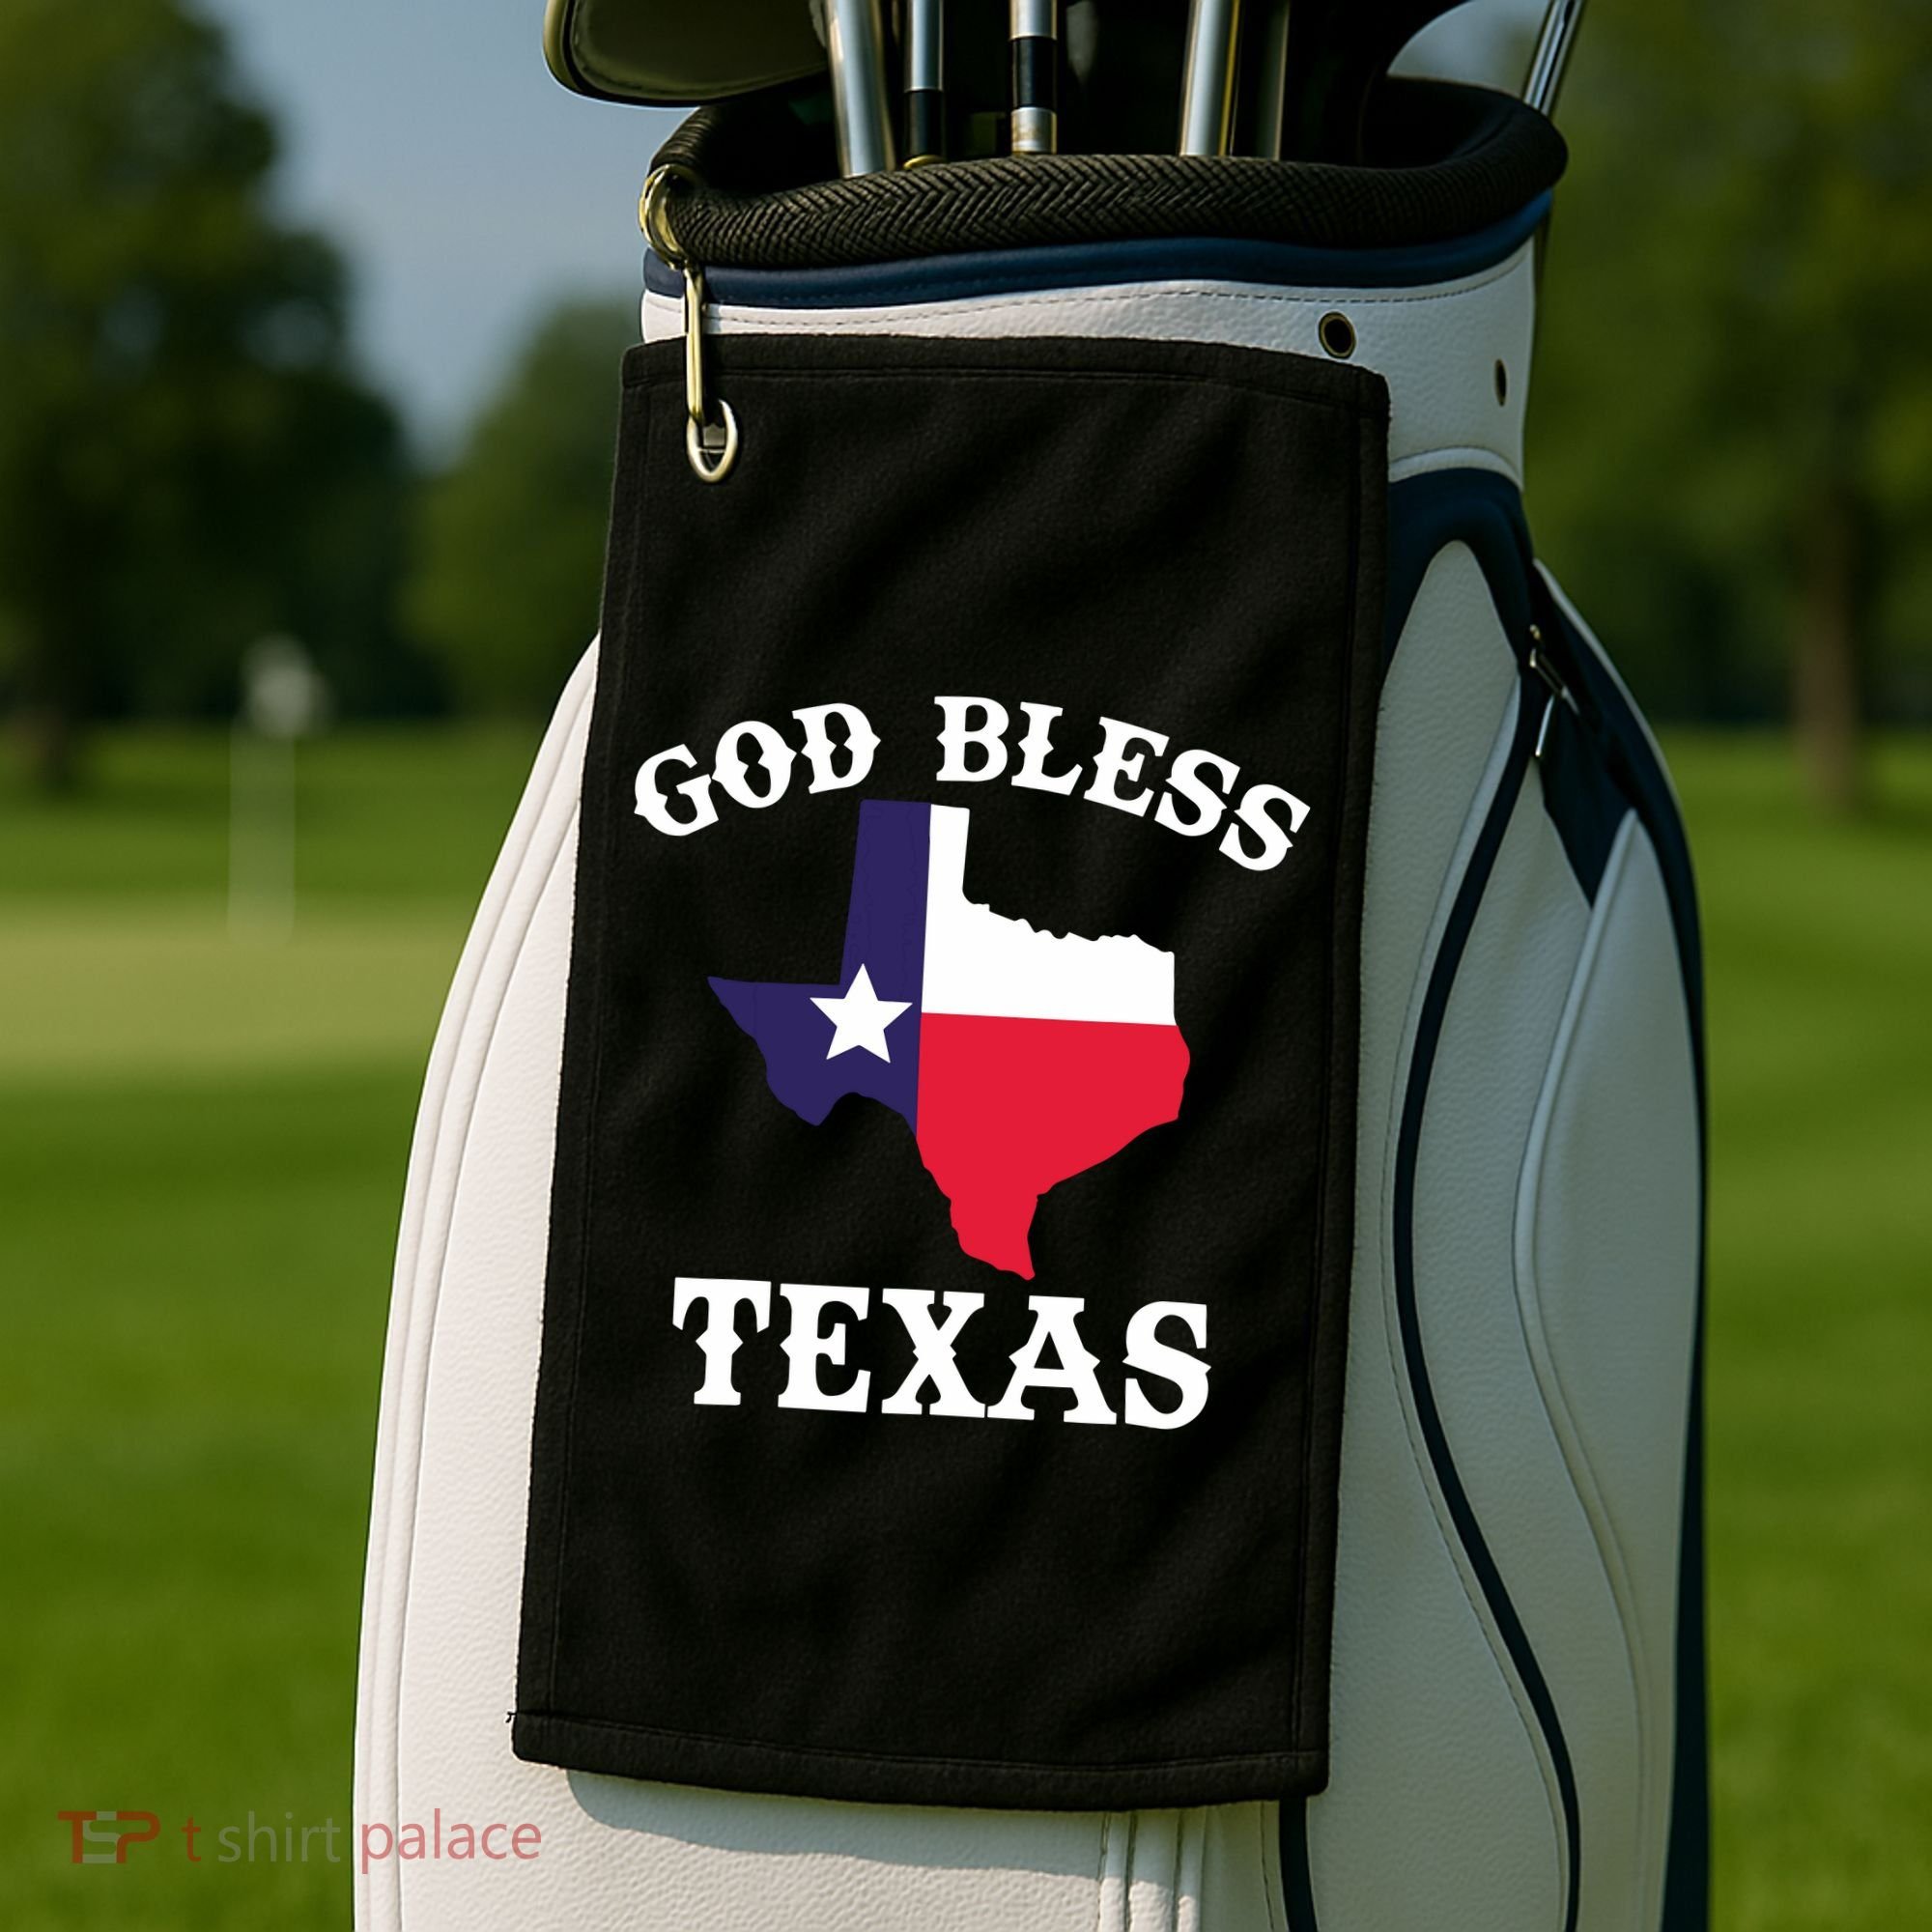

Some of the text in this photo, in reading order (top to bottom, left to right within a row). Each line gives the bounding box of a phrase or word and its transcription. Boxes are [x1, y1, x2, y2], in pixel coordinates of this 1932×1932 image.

[634, 696, 1311, 871] GOD BLESS
[672, 1277, 1213, 1430] TEXAS
